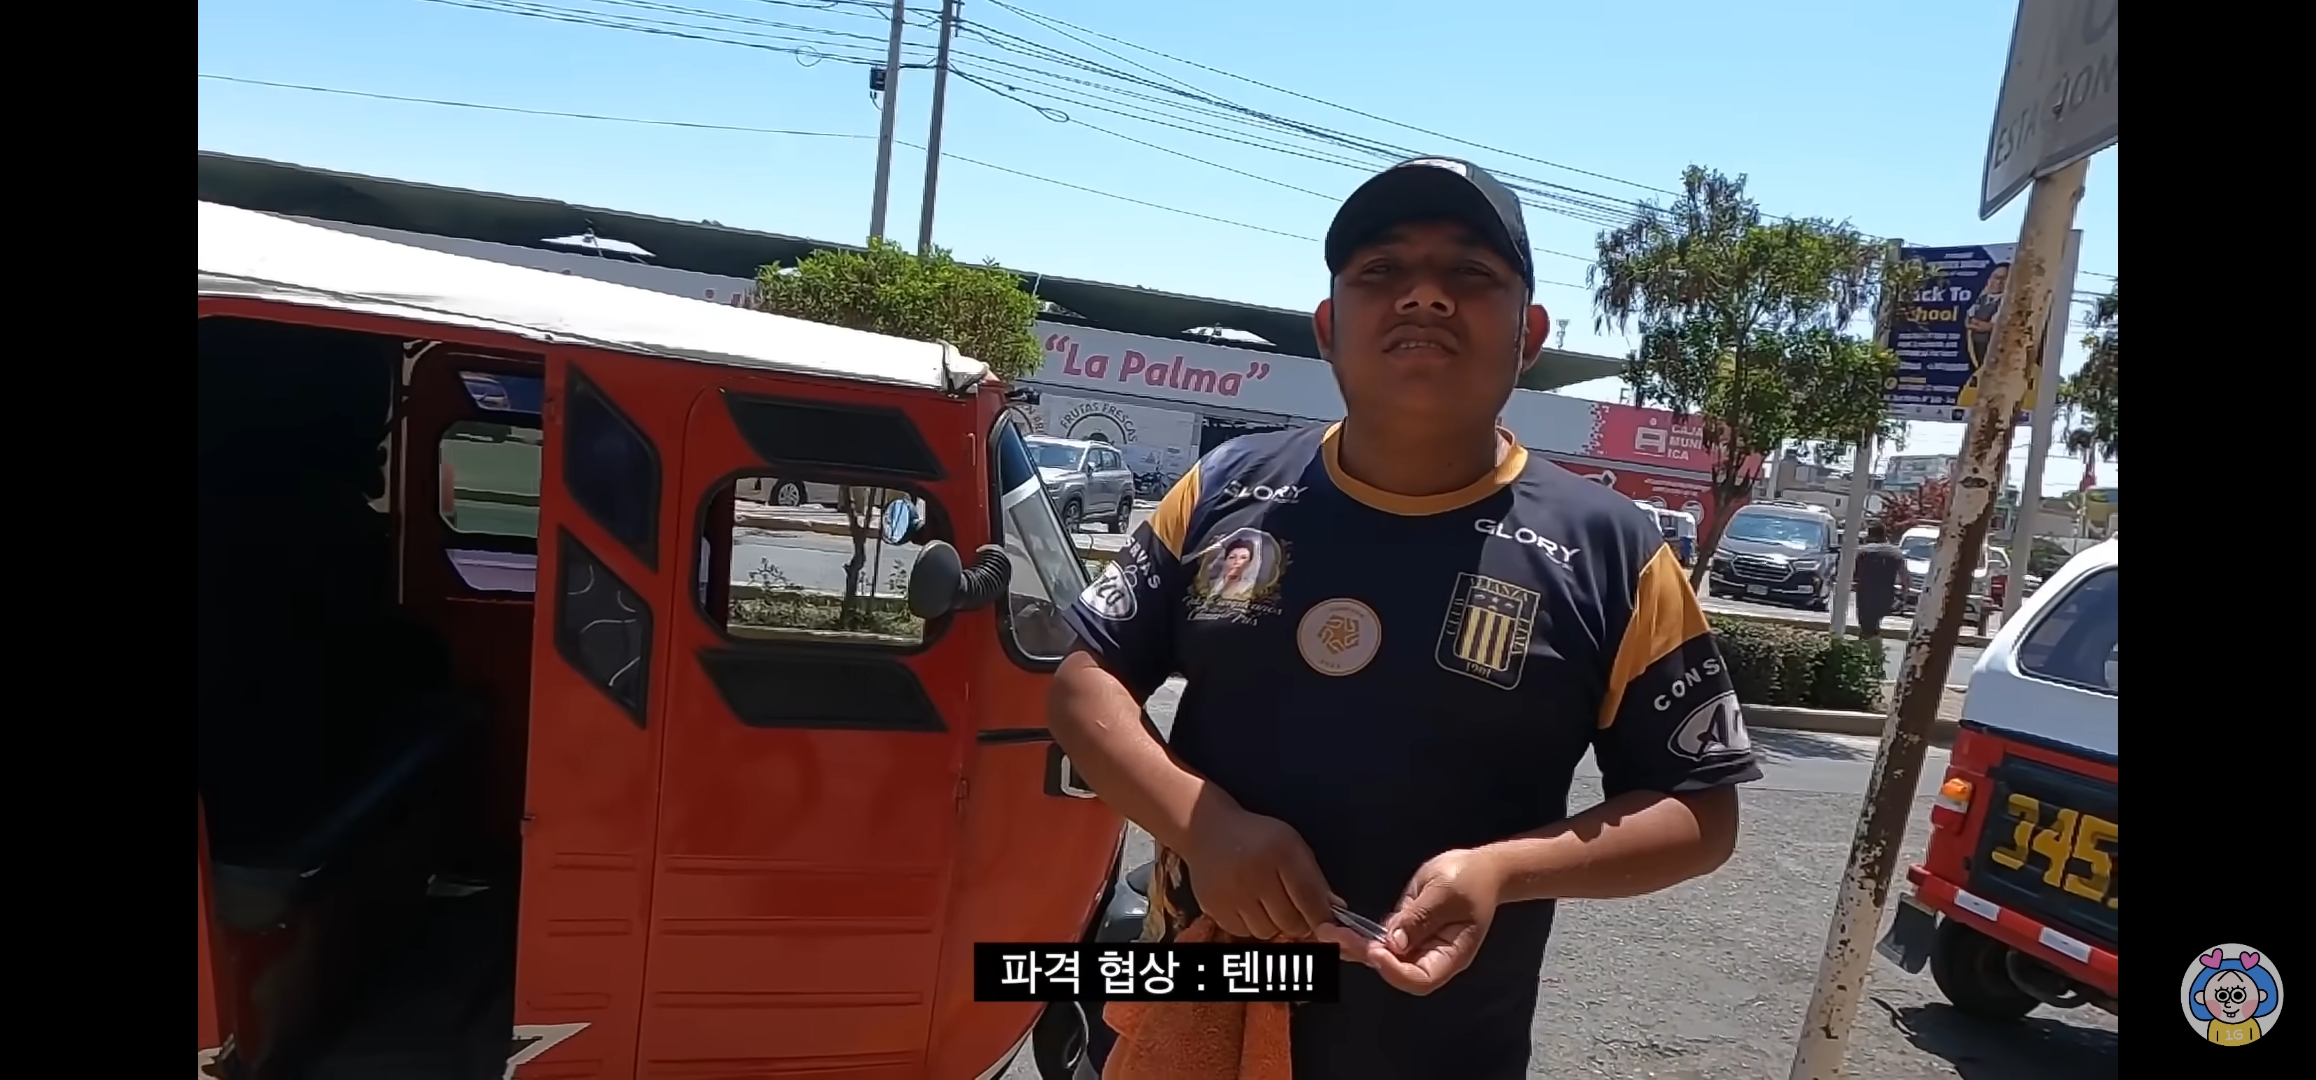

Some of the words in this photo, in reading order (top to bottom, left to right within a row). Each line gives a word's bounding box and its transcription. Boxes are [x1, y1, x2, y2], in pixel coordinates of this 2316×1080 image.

[1949, 286, 1972, 301] To
[1060, 402, 1099, 430] FRUTAS
[1102, 403, 1138, 442] FRESCAS
[1672, 424, 1704, 437] CAJA
[1667, 448, 1689, 460] ICA
[1224, 480, 1309, 500] GLORY
[1474, 519, 1581, 562] GLORY
[1466, 661, 1492, 678] 1901
